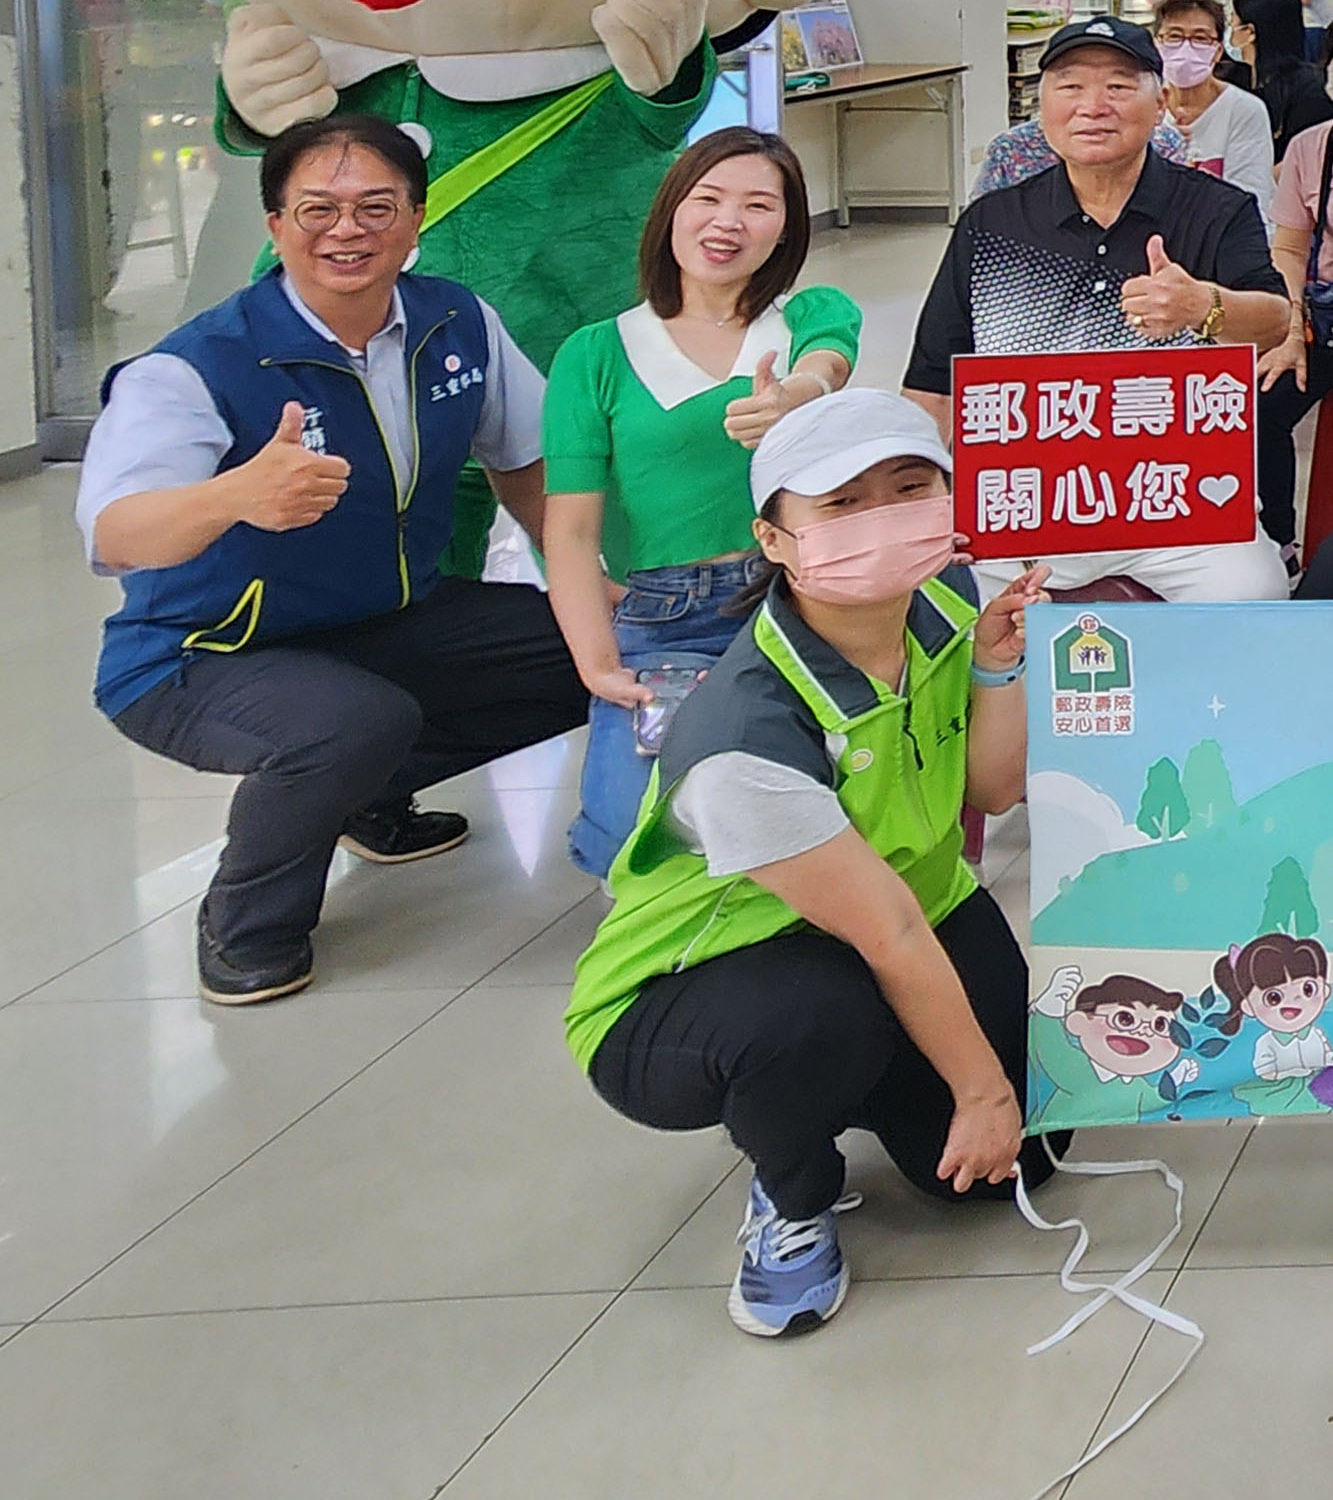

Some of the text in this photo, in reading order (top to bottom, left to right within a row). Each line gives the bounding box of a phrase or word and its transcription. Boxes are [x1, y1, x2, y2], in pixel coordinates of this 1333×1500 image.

[962, 372, 1249, 444] 郵政壽險
[977, 461, 1191, 533] 關心您
[1055, 695, 1132, 713] 郵政壽險
[1055, 716, 1132, 733] 安心首選
